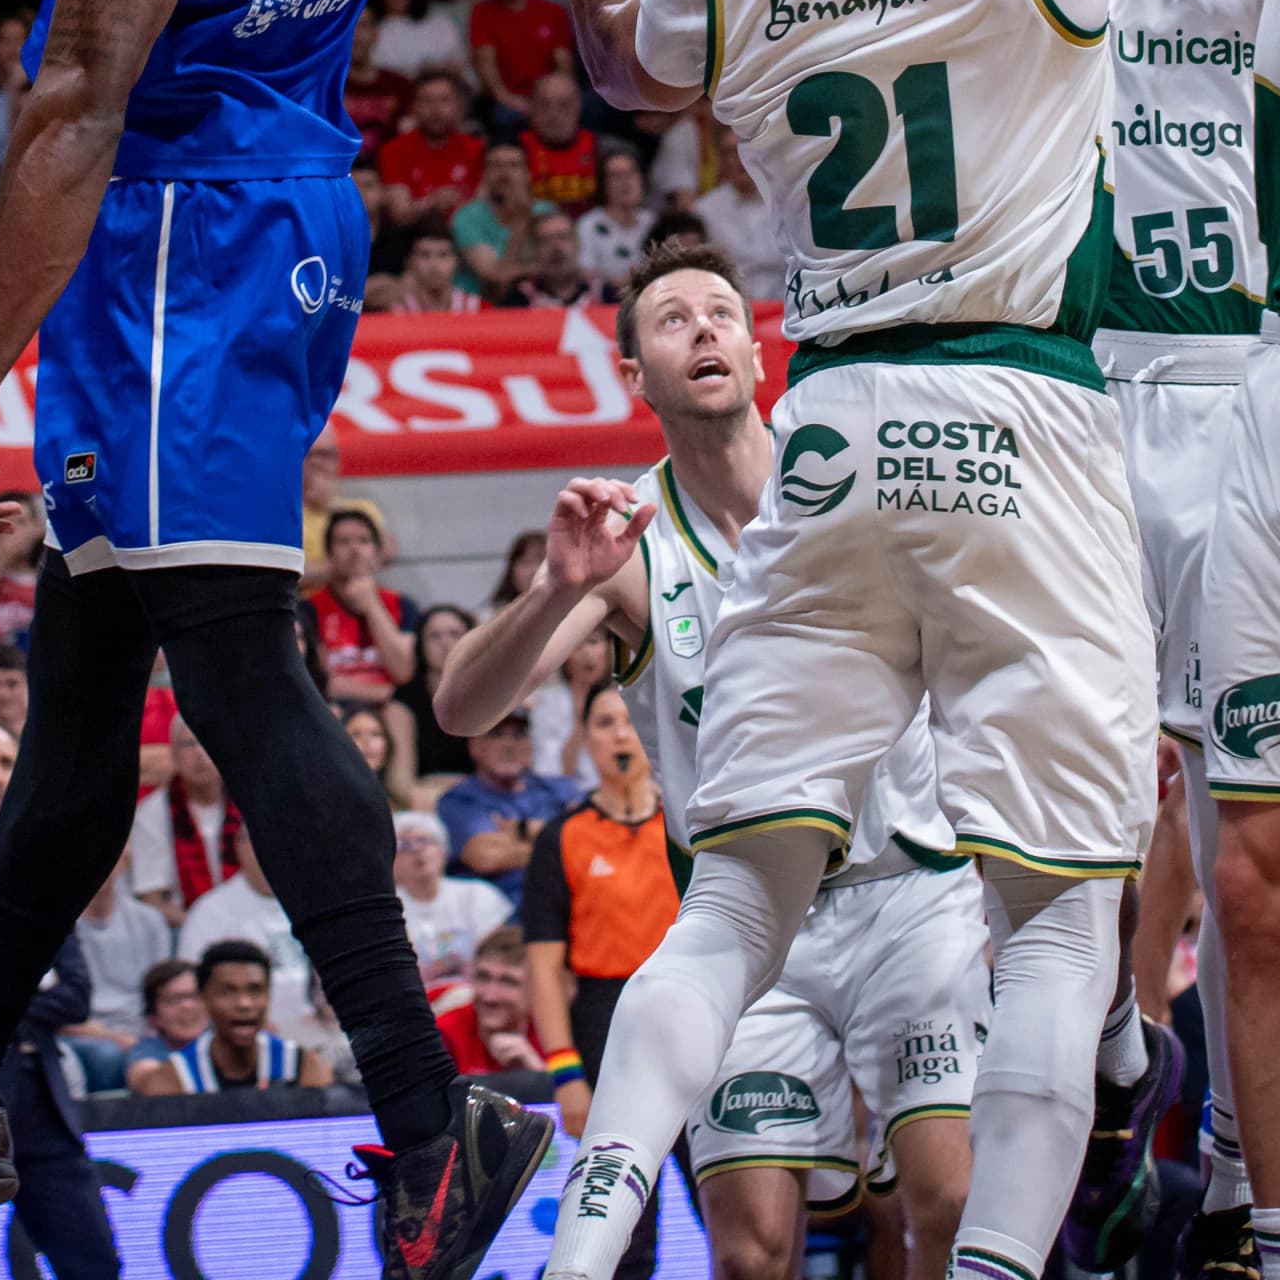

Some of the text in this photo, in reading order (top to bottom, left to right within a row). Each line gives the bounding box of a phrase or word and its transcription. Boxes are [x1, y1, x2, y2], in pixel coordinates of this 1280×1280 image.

[786, 60, 959, 250] 21
[1131, 205, 1236, 300] 55
[876, 419, 1021, 458] COSTA
[66, 464, 89, 480] acb
[876, 456, 1022, 489] DEL SOL
[876, 483, 1022, 519] MÁLAGA
[896, 1055, 963, 1086] laga
[721, 1076, 815, 1121] famadesa
[577, 1154, 626, 1220] UNICAJA
